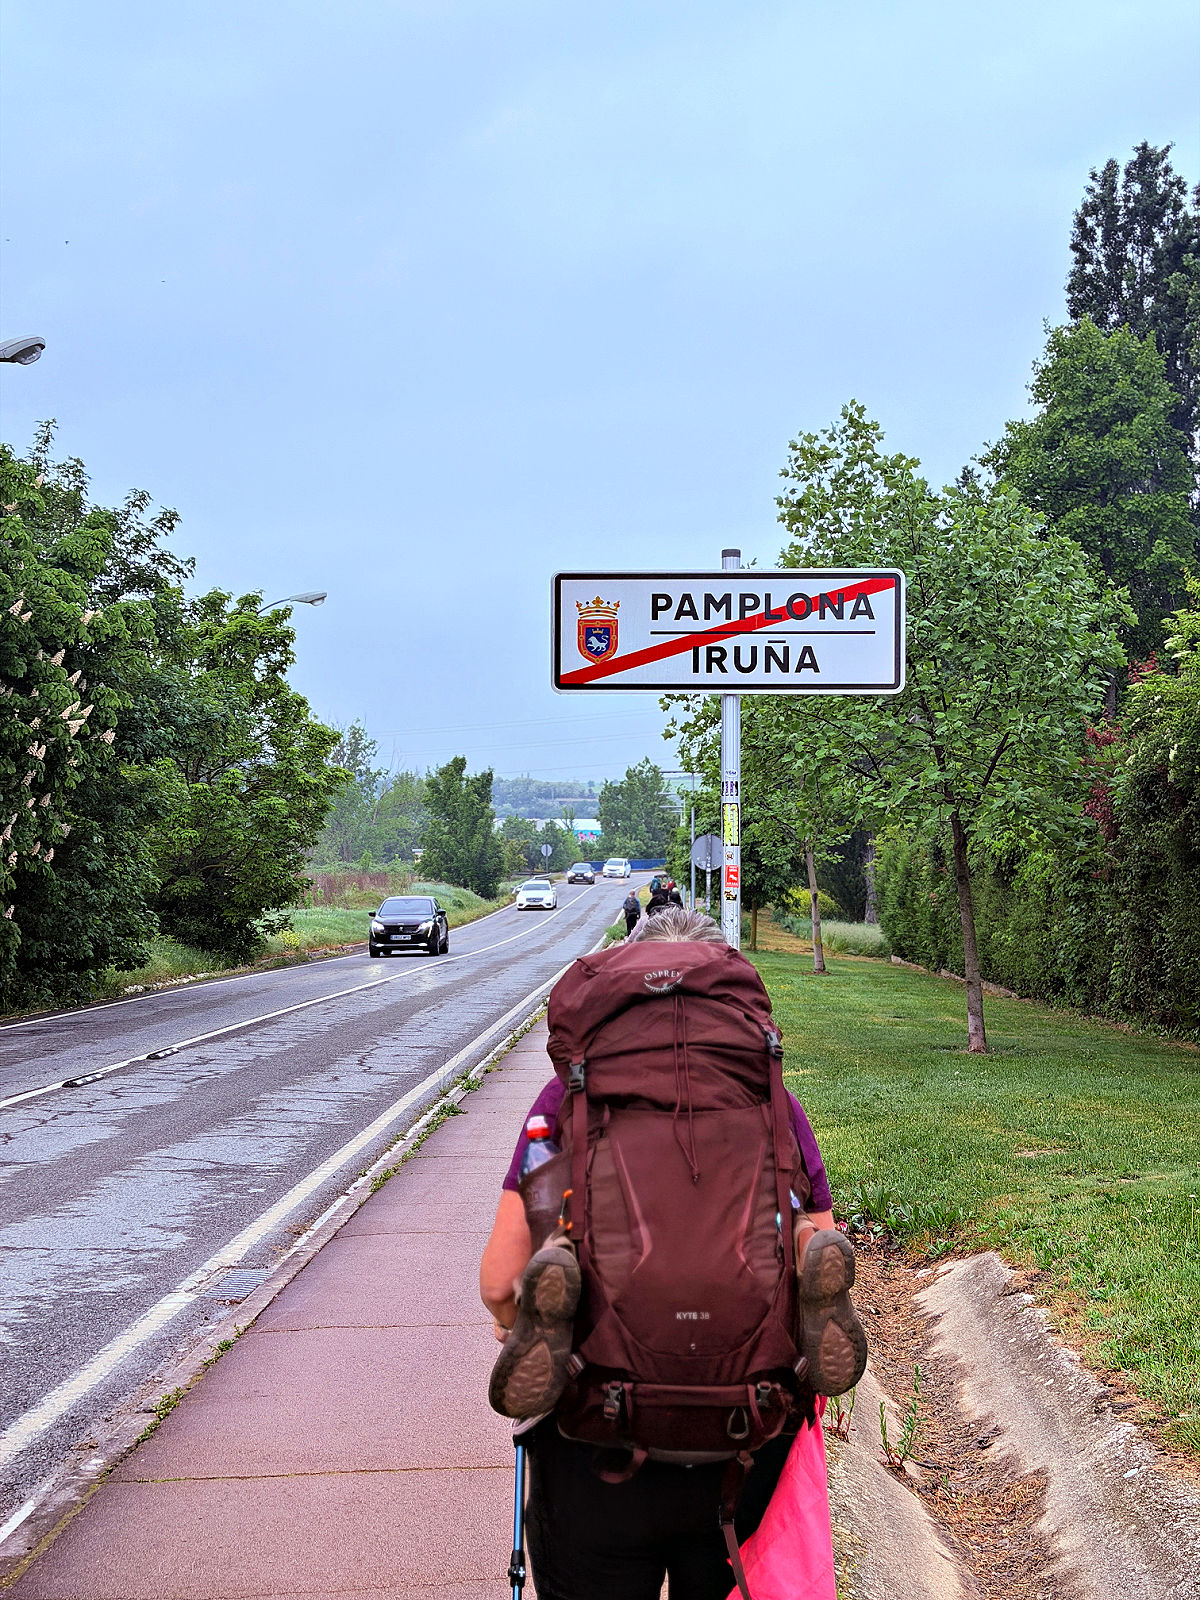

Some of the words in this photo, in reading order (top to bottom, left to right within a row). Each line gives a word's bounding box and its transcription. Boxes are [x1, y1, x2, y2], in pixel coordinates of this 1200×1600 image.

[651, 593, 875, 620] PAMPLONA
[692, 640, 820, 673] IRUÑA
[676, 1312, 697, 1320] KYTE
[700, 1312, 710, 1320] 38
